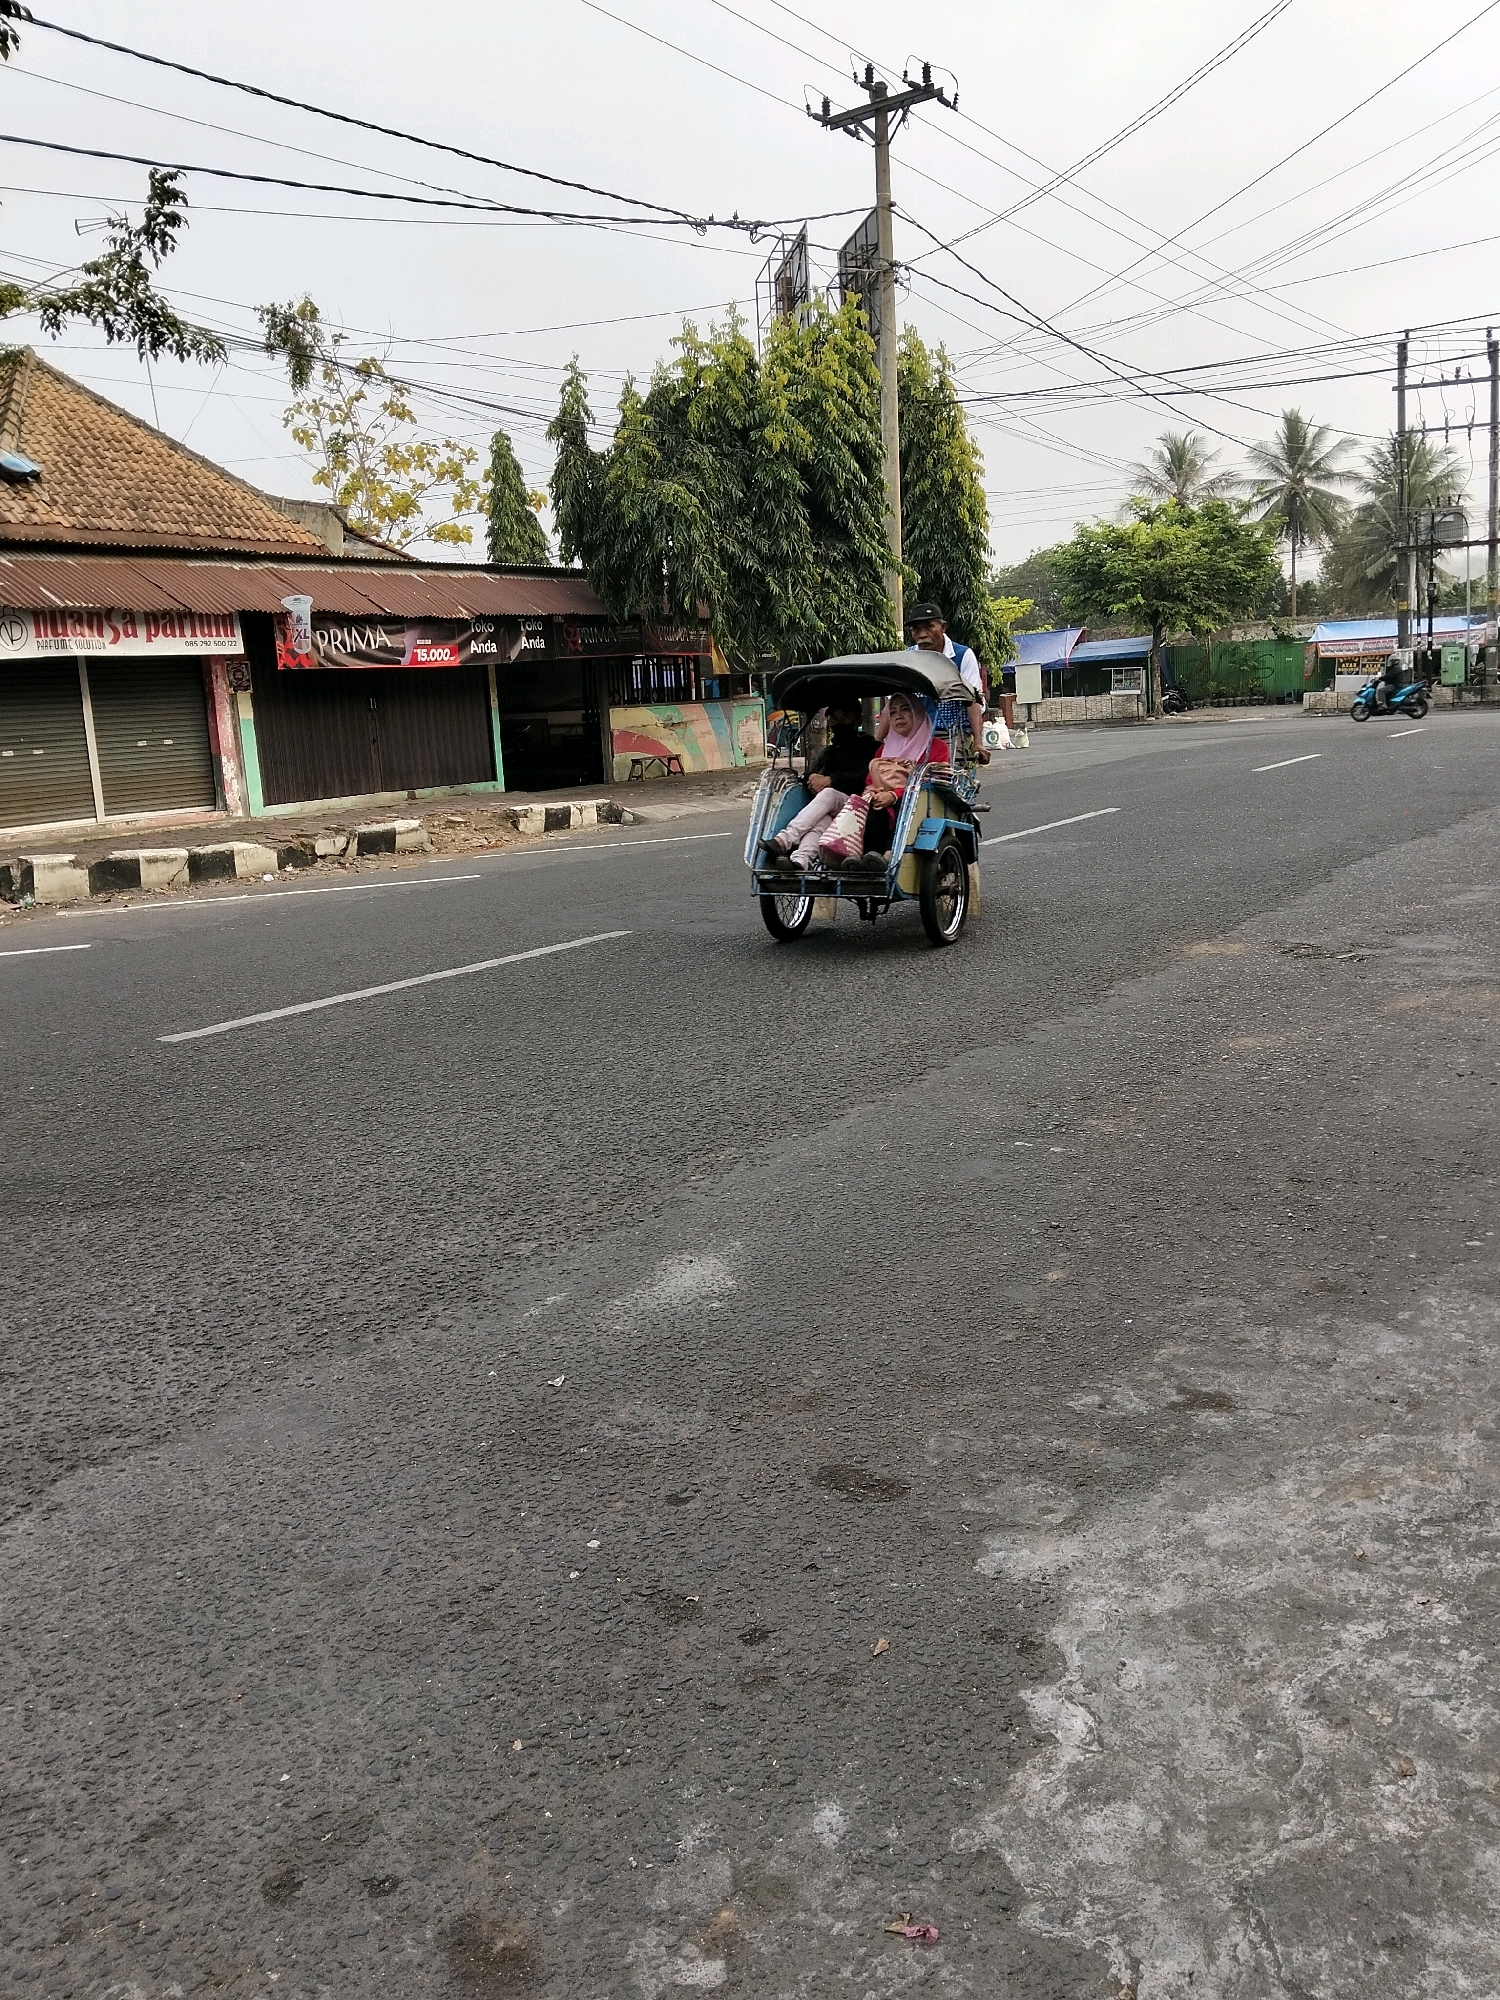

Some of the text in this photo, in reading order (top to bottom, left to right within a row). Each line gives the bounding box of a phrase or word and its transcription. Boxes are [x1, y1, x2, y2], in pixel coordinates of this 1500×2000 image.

[469, 619, 495, 633] Toko
[517, 618, 543, 632] Toko
[316, 624, 393, 657] PRIMA
[577, 626, 617, 644] PRIMA
[658, 625, 689, 642] PRIMA
[37, 639, 107, 651] PARFUME SOLUTION
[470, 639, 498, 654] Anda
[521, 635, 546, 650] Anda
